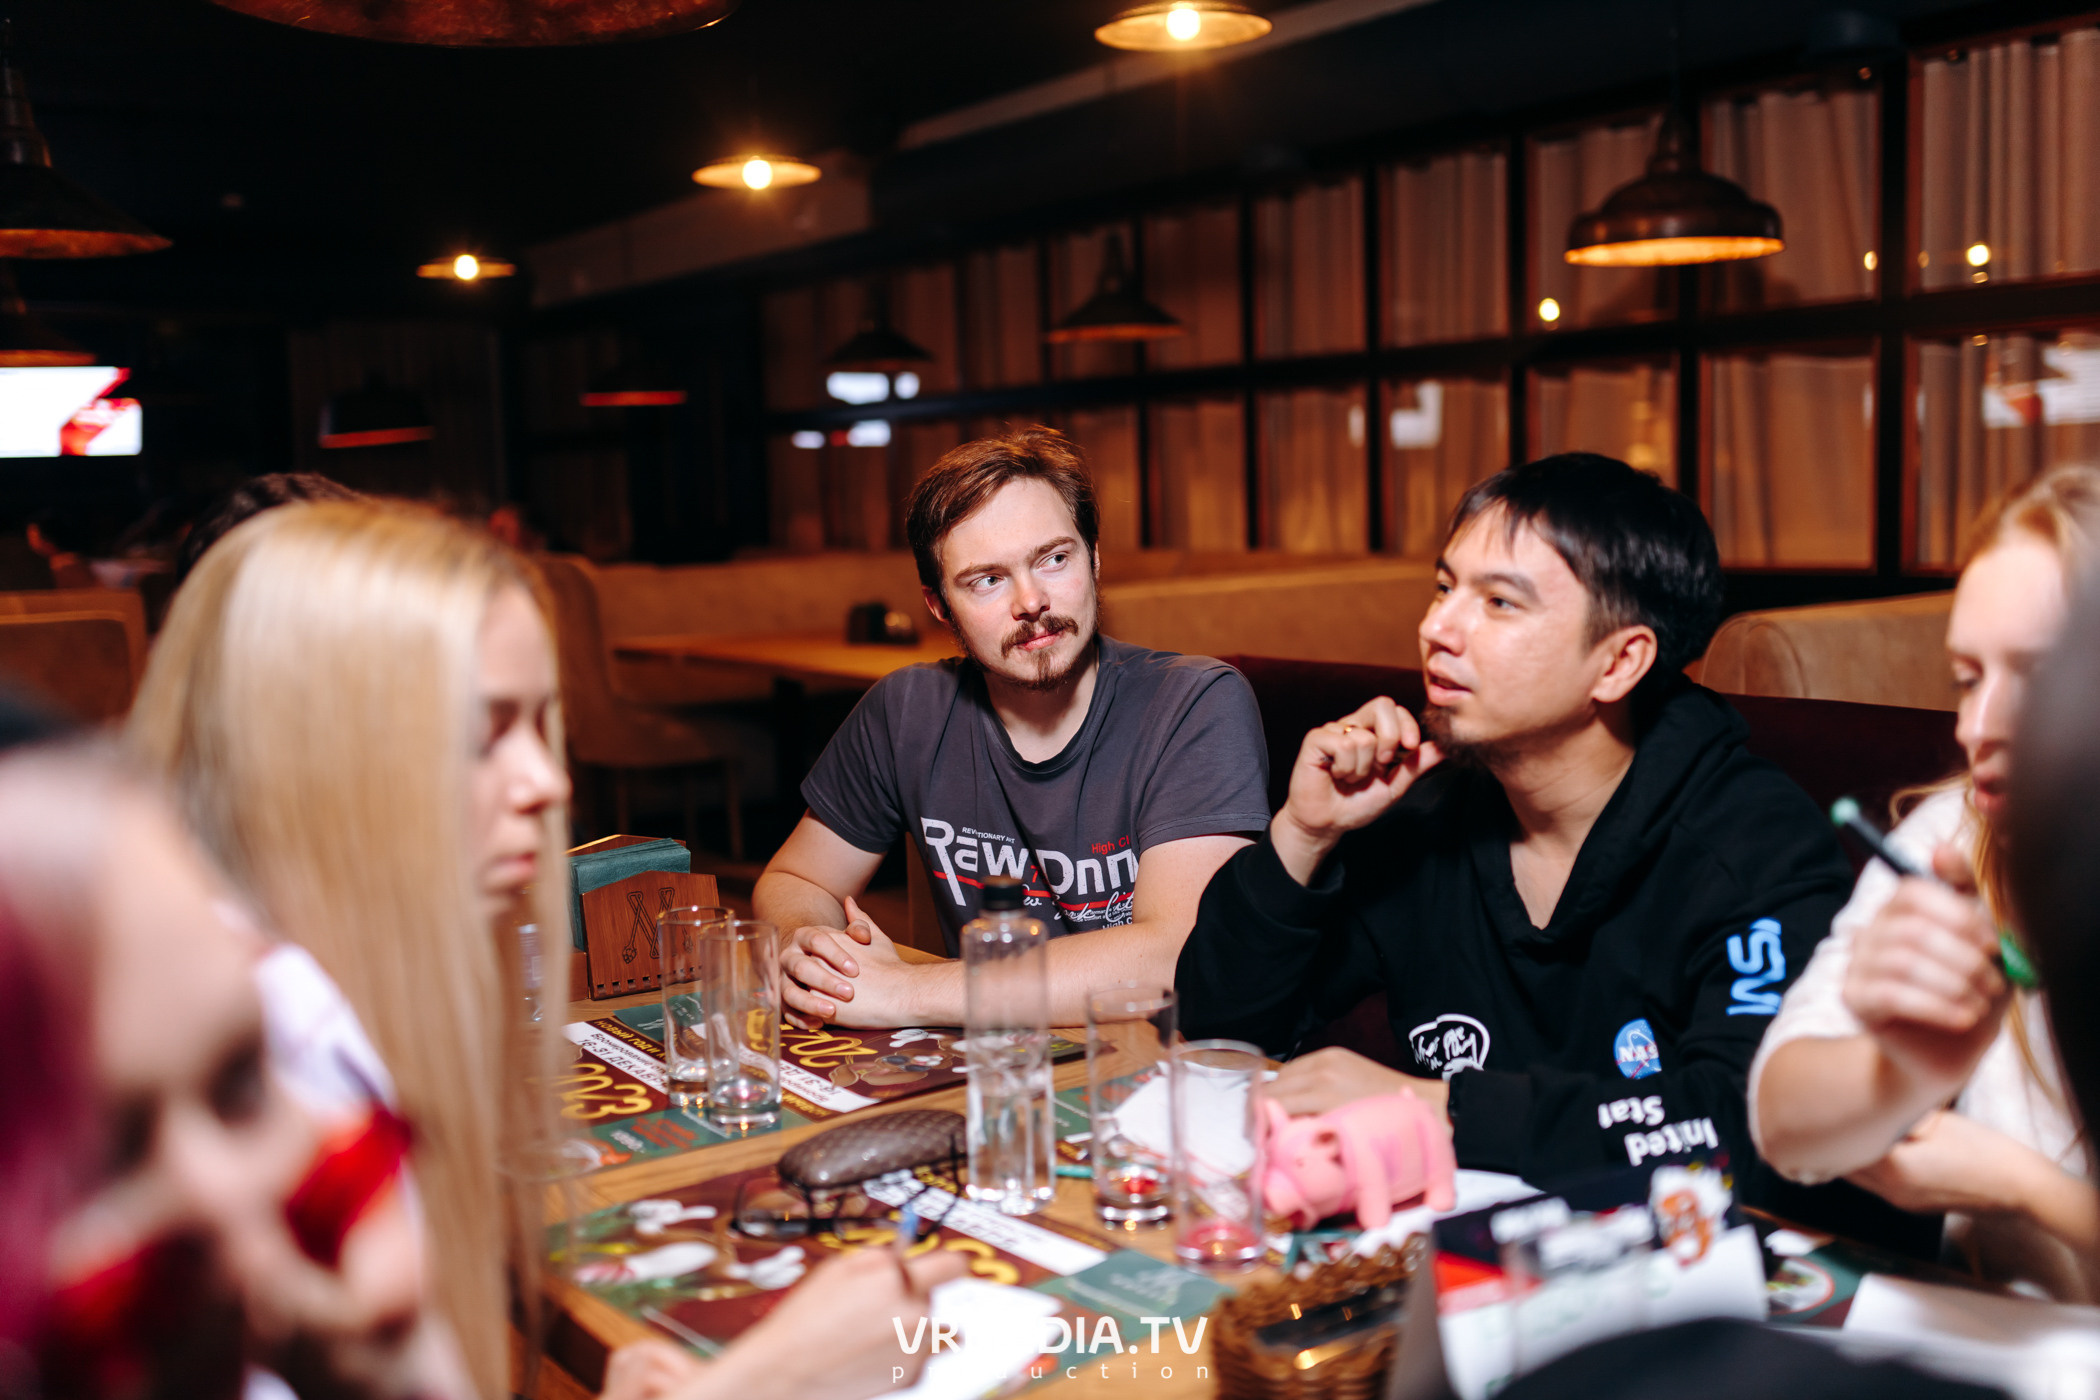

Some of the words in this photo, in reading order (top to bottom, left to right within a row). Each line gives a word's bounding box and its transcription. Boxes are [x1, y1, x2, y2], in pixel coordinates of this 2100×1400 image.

[1092, 841, 1115, 855] High
[1118, 835, 1130, 847] Cl
[1105, 891, 1134, 922] Cit
[1618, 1043, 1659, 1063] NAS
